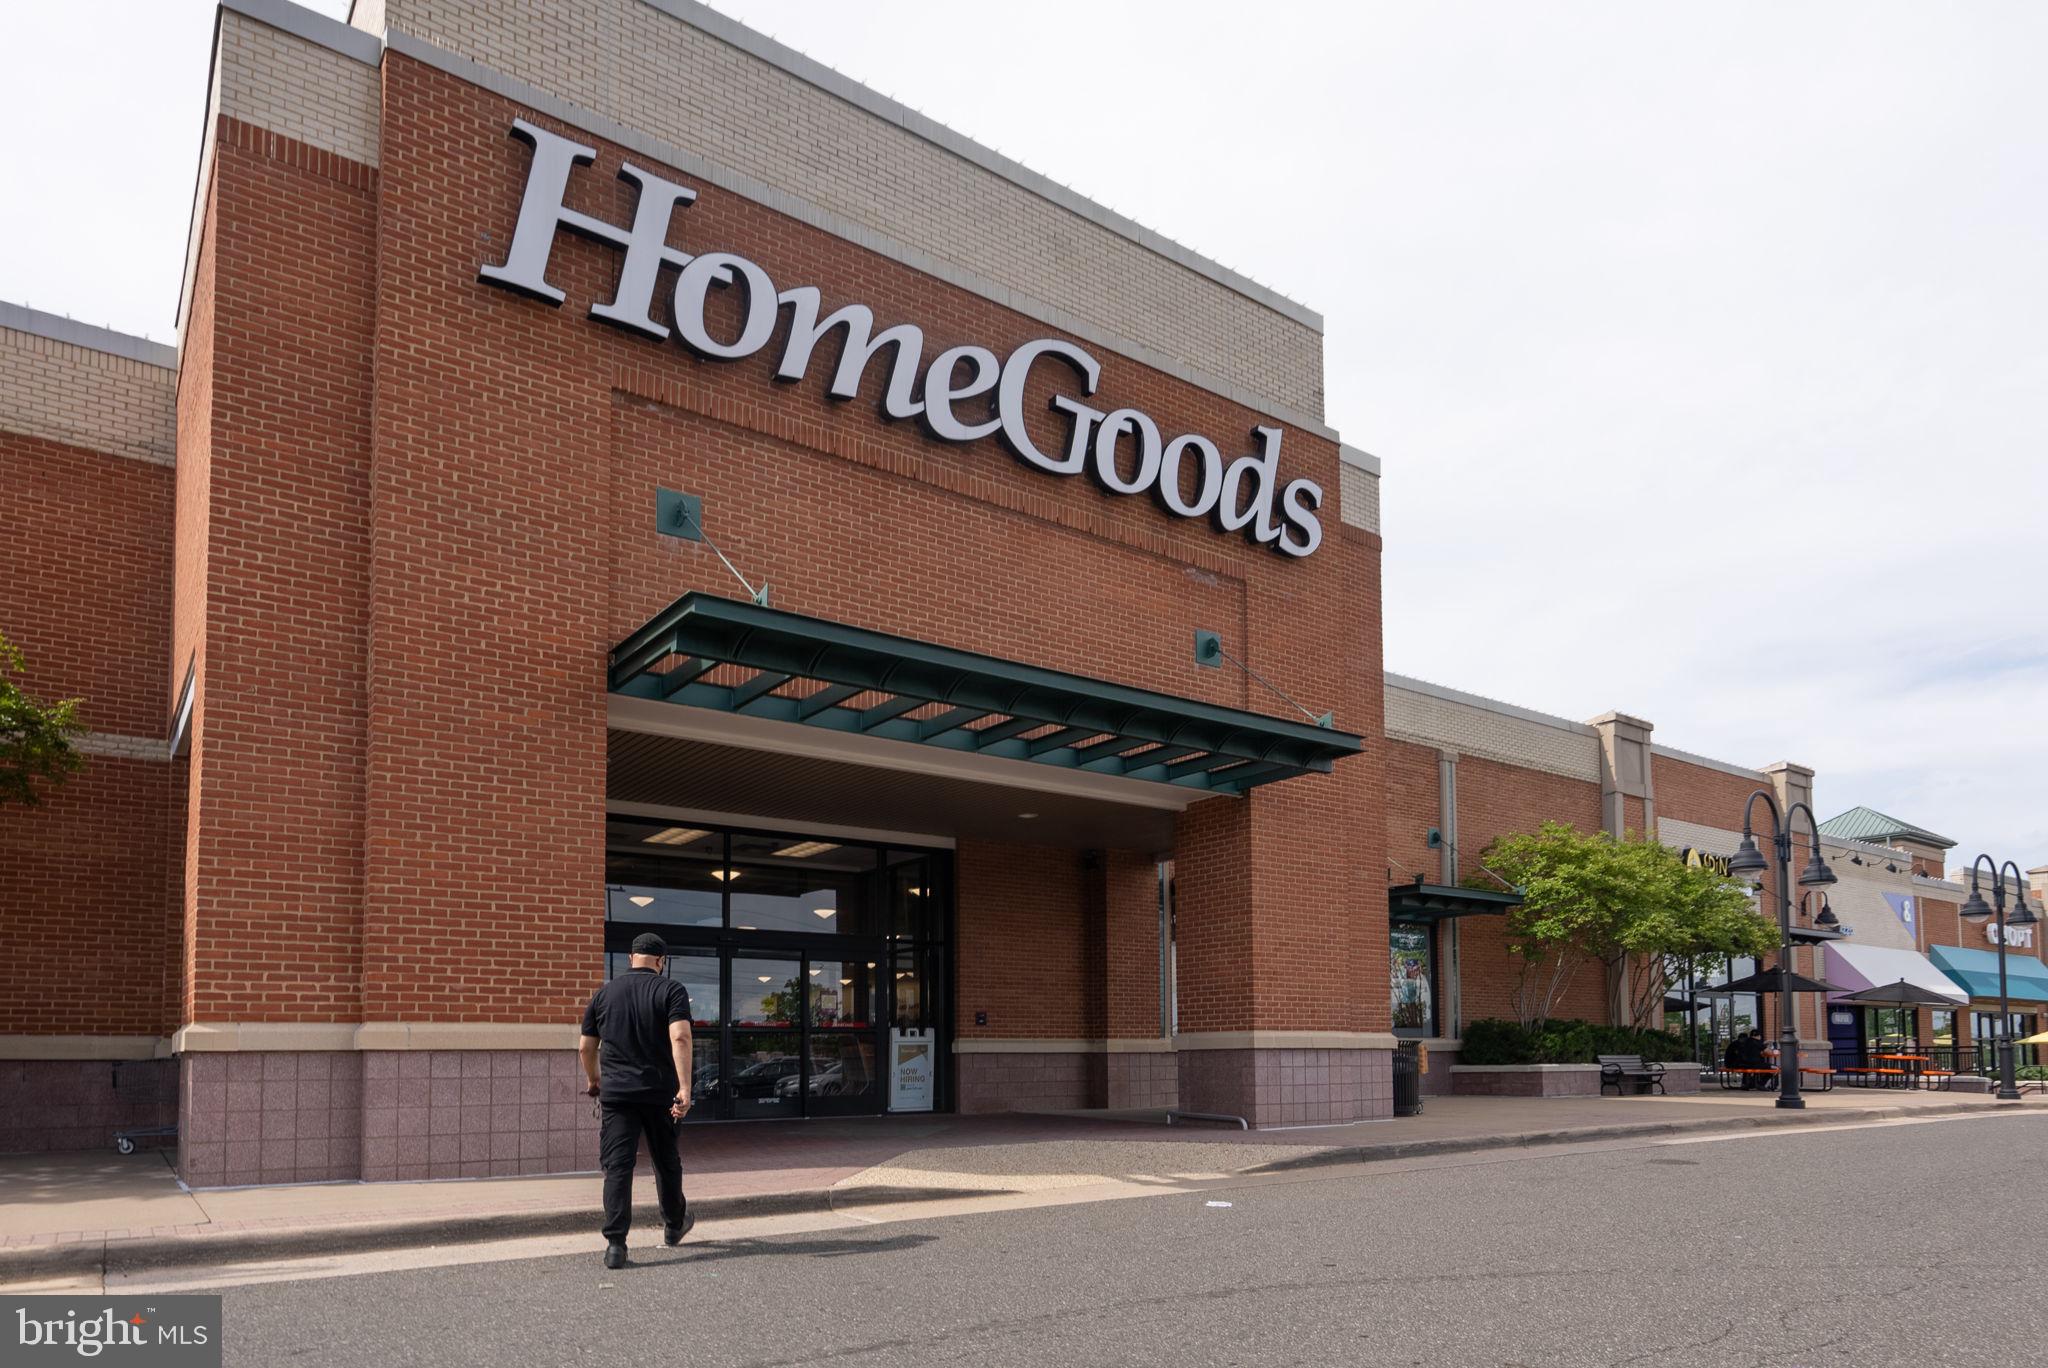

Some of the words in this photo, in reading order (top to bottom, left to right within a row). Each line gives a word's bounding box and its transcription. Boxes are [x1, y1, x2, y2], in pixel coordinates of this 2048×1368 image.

[477, 117, 1324, 559] HomeGoods
[900, 1067, 918, 1075] NOW
[900, 1075, 926, 1083] HIRING
